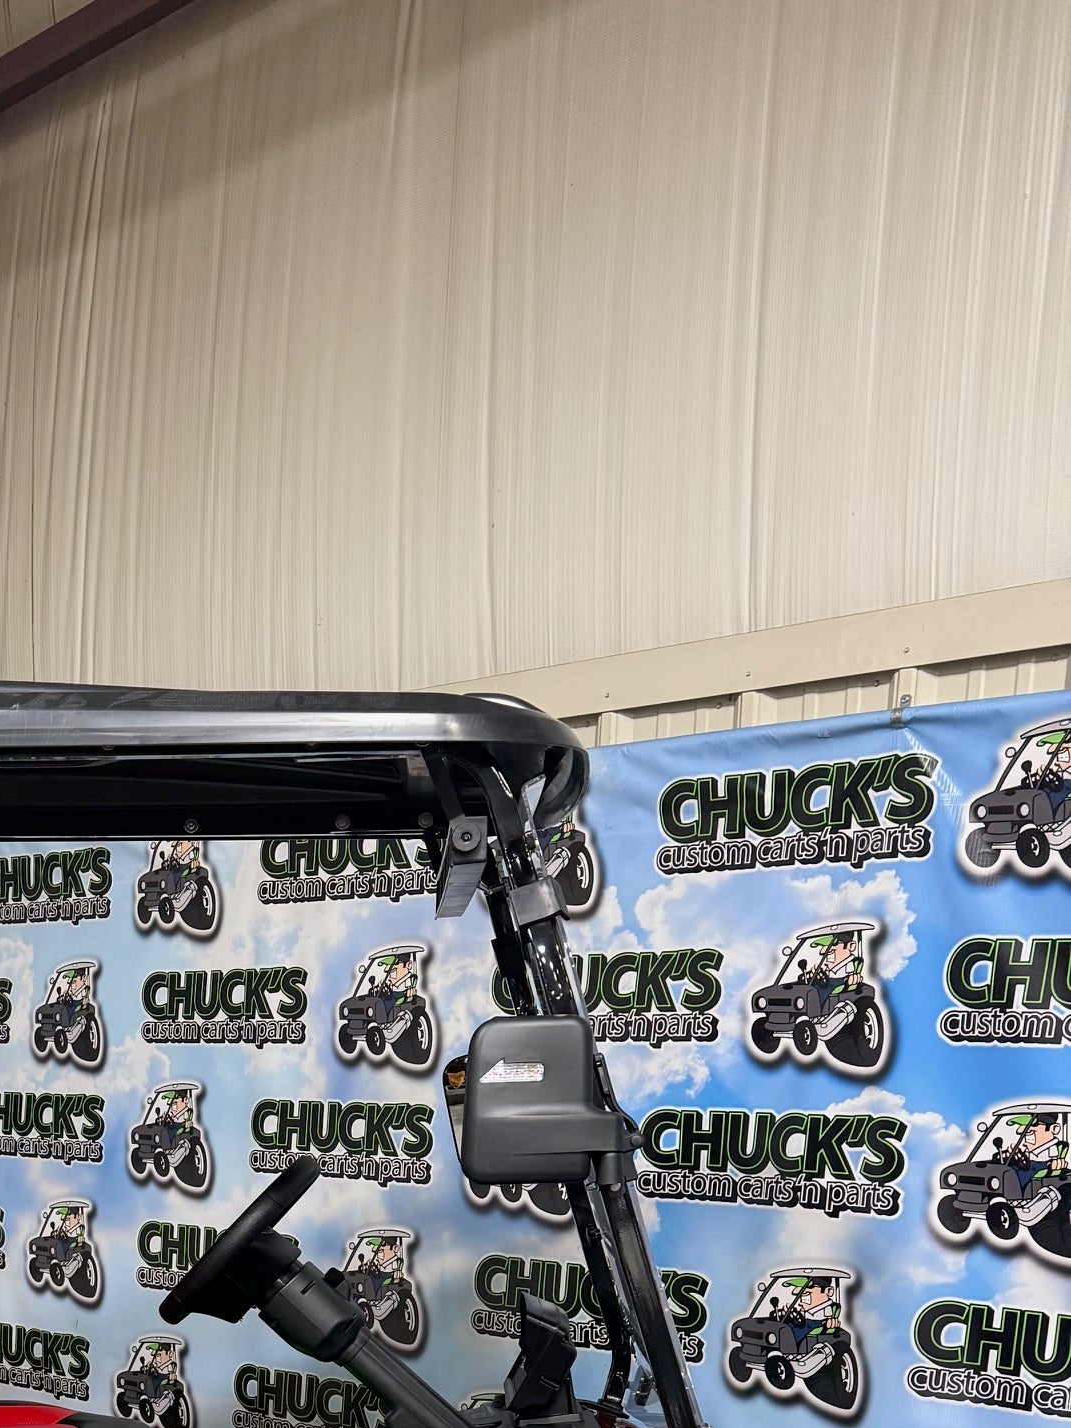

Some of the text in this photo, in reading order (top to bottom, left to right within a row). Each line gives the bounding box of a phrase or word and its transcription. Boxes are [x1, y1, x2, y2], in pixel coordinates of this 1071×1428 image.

[659, 753, 939, 843] CHUCK'S
[260, 838, 431, 879] CHUCK
[657, 840, 752, 870] custom
[852, 823, 926, 864] parts
[258, 876, 323, 902] custom
[390, 866, 438, 897] parts
[73, 896, 109, 921] parts
[142, 967, 308, 1019] CHUCK'S
[141, 1019, 199, 1040] custom
[256, 1019, 303, 1046] parts
[651, 1011, 713, 1044] parts
[941, 1007, 1059, 1039] custom
[251, 1099, 434, 1157] CHUCK'S
[64, 1138, 102, 1161] parts
[640, 1109, 908, 1184] CHUCK'S
[249, 1149, 314, 1170] custo
[378, 1155, 428, 1182] parts
[637, 1169, 733, 1198] custom
[825, 1180, 895, 1212] parts
[136, 1265, 187, 1288] custo
[52, 1375, 87, 1398] parts
[908, 1365, 1028, 1407] custom
